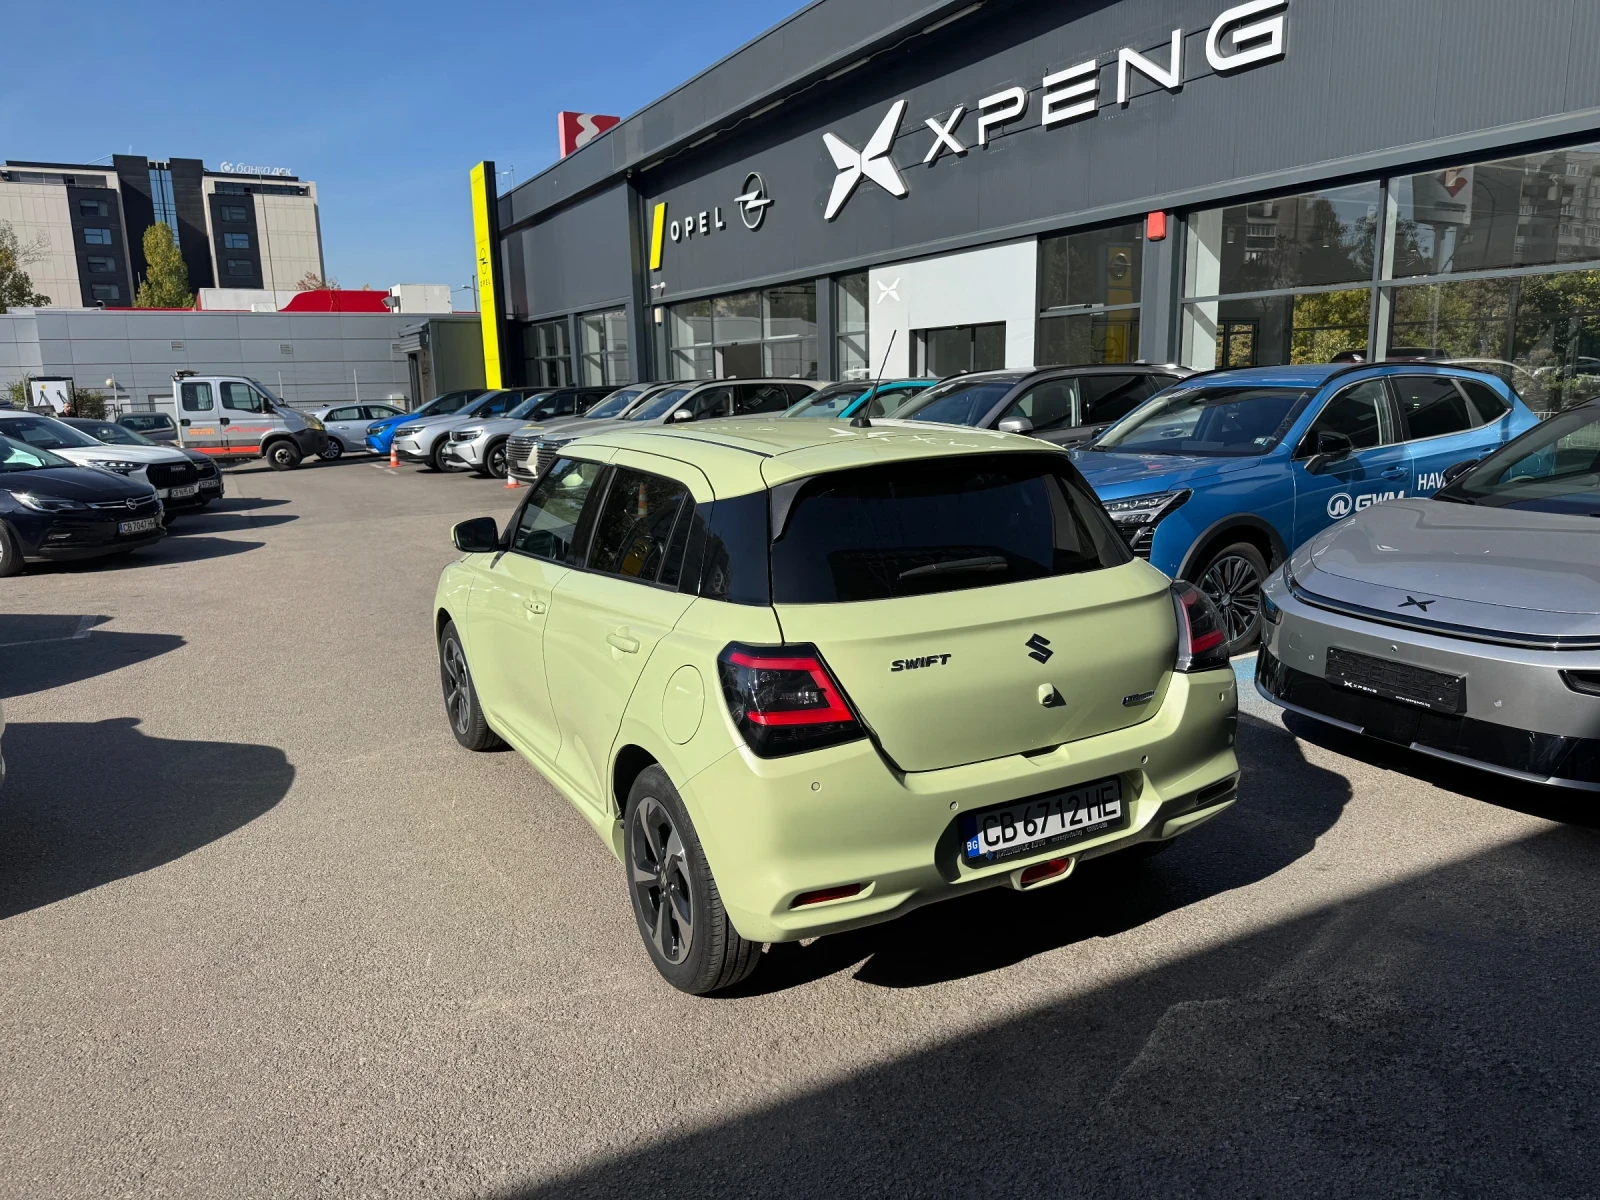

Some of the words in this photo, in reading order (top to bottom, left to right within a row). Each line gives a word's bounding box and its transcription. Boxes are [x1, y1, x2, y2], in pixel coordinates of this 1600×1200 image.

[922, 0, 1288, 163] XPENG
[236, 162, 271, 175] банка
[670, 206, 724, 241] OPEL
[123, 522, 133, 532] CB
[133, 520, 147, 530] 7047
[890, 653, 952, 672] SWIFT
[982, 812, 1018, 847] CB
[1023, 794, 1083, 838] 6712
[1085, 786, 1117, 822] HE
[966, 840, 978, 851] BG
